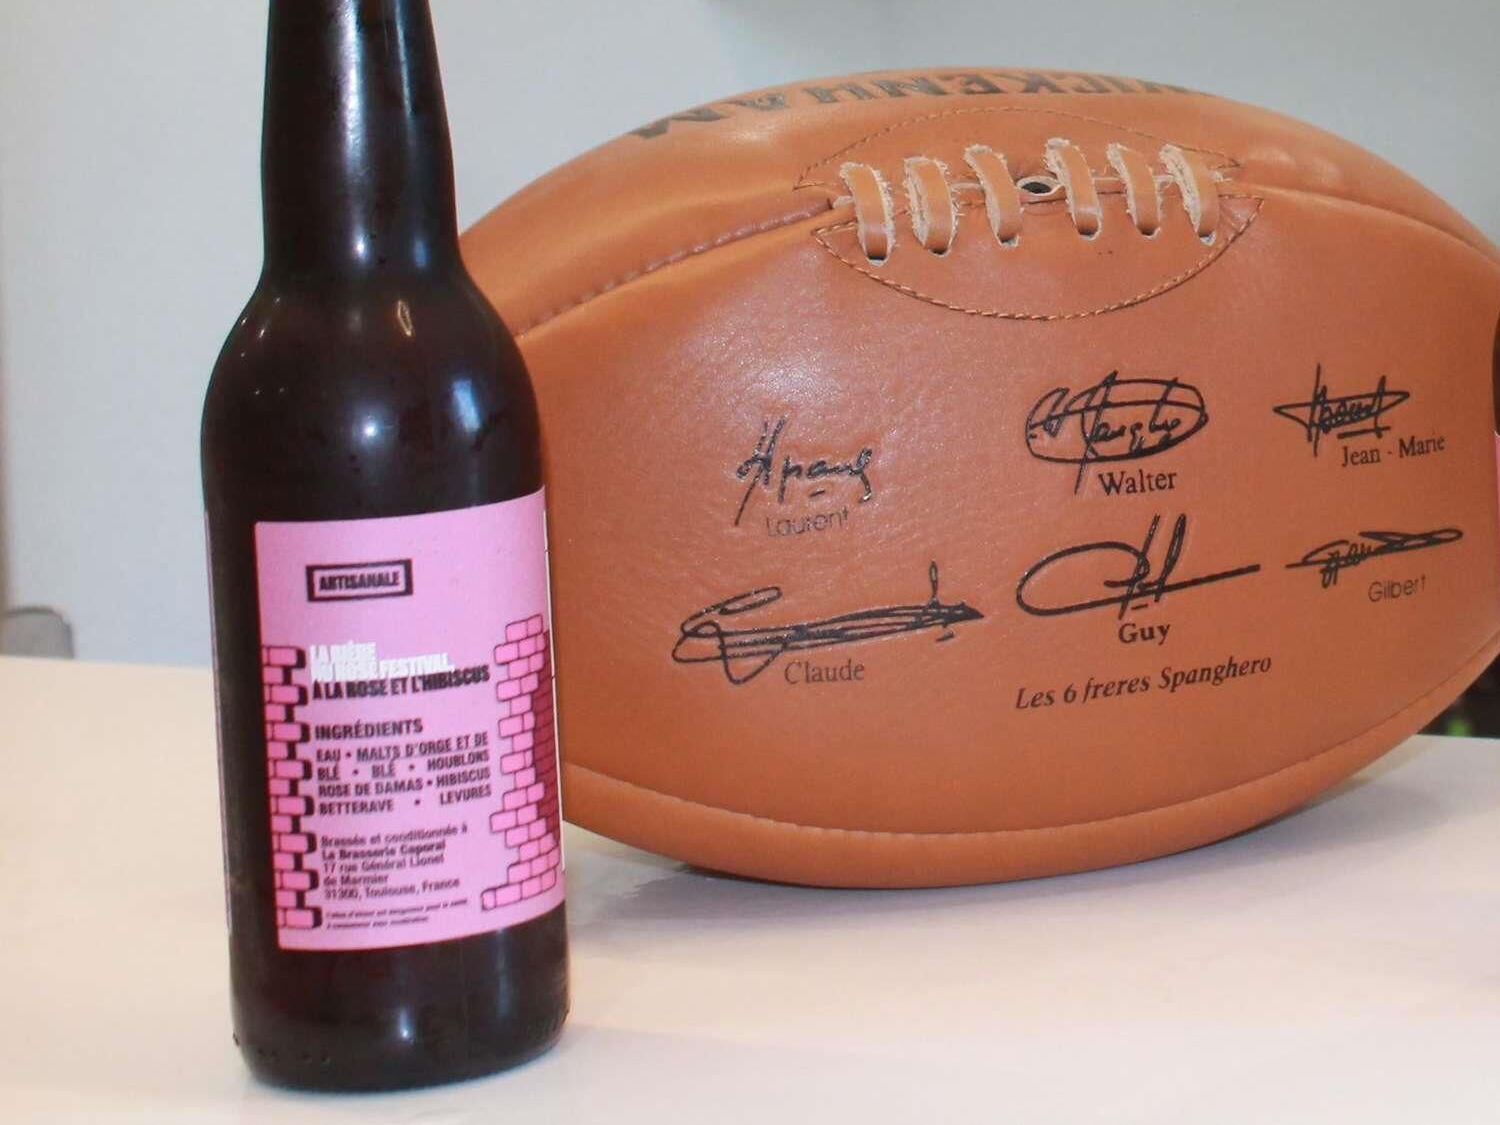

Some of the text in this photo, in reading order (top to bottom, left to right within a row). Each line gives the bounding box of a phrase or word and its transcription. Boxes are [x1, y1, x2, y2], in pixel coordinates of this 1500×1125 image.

[1341, 446, 1381, 468] Jean
[1398, 435, 1446, 458] Marie
[1098, 469, 1177, 496] Walter
[765, 507, 850, 538] Laurent
[319, 571, 400, 591] ARTISANALE
[1367, 575, 1426, 602] Gilbert
[1118, 623, 1171, 645] Guy
[783, 658, 866, 685] Claude
[1015, 655, 1272, 709] Les 6 freres Spanghero
[324, 681, 343, 700] LA
[345, 680, 388, 699] ROSE
[390, 677, 408, 696] ET
[315, 718, 424, 741] INGRÉDIENTS
[316, 731, 489, 763] EAU MALTS D'ORGE ET DE
[317, 748, 490, 782] BLÉ BLÉ HOUBLONS
[318, 766, 492, 797] ROSE DE DAMAS HIBISCUS
[320, 783, 493, 816] BETTERAVE LEVURES
